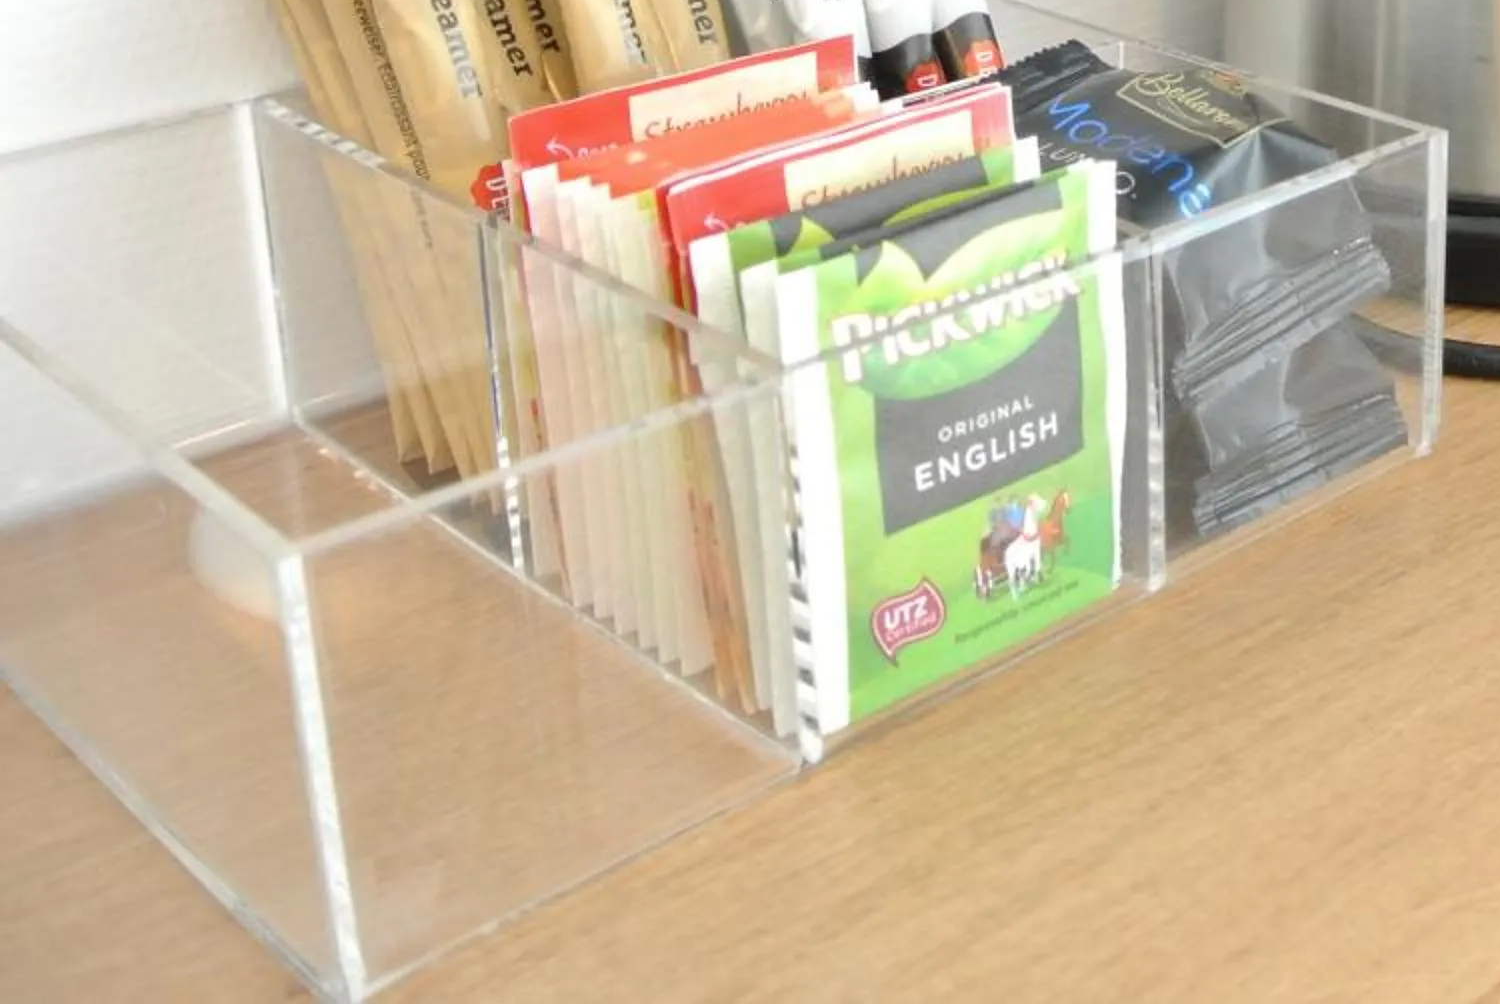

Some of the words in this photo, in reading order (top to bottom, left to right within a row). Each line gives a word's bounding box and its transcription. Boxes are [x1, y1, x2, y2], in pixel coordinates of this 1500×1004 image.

[938, 394, 1034, 444] ORIGINAL
[913, 412, 1059, 492] ENGLISH
[884, 595, 928, 629] UTZ
